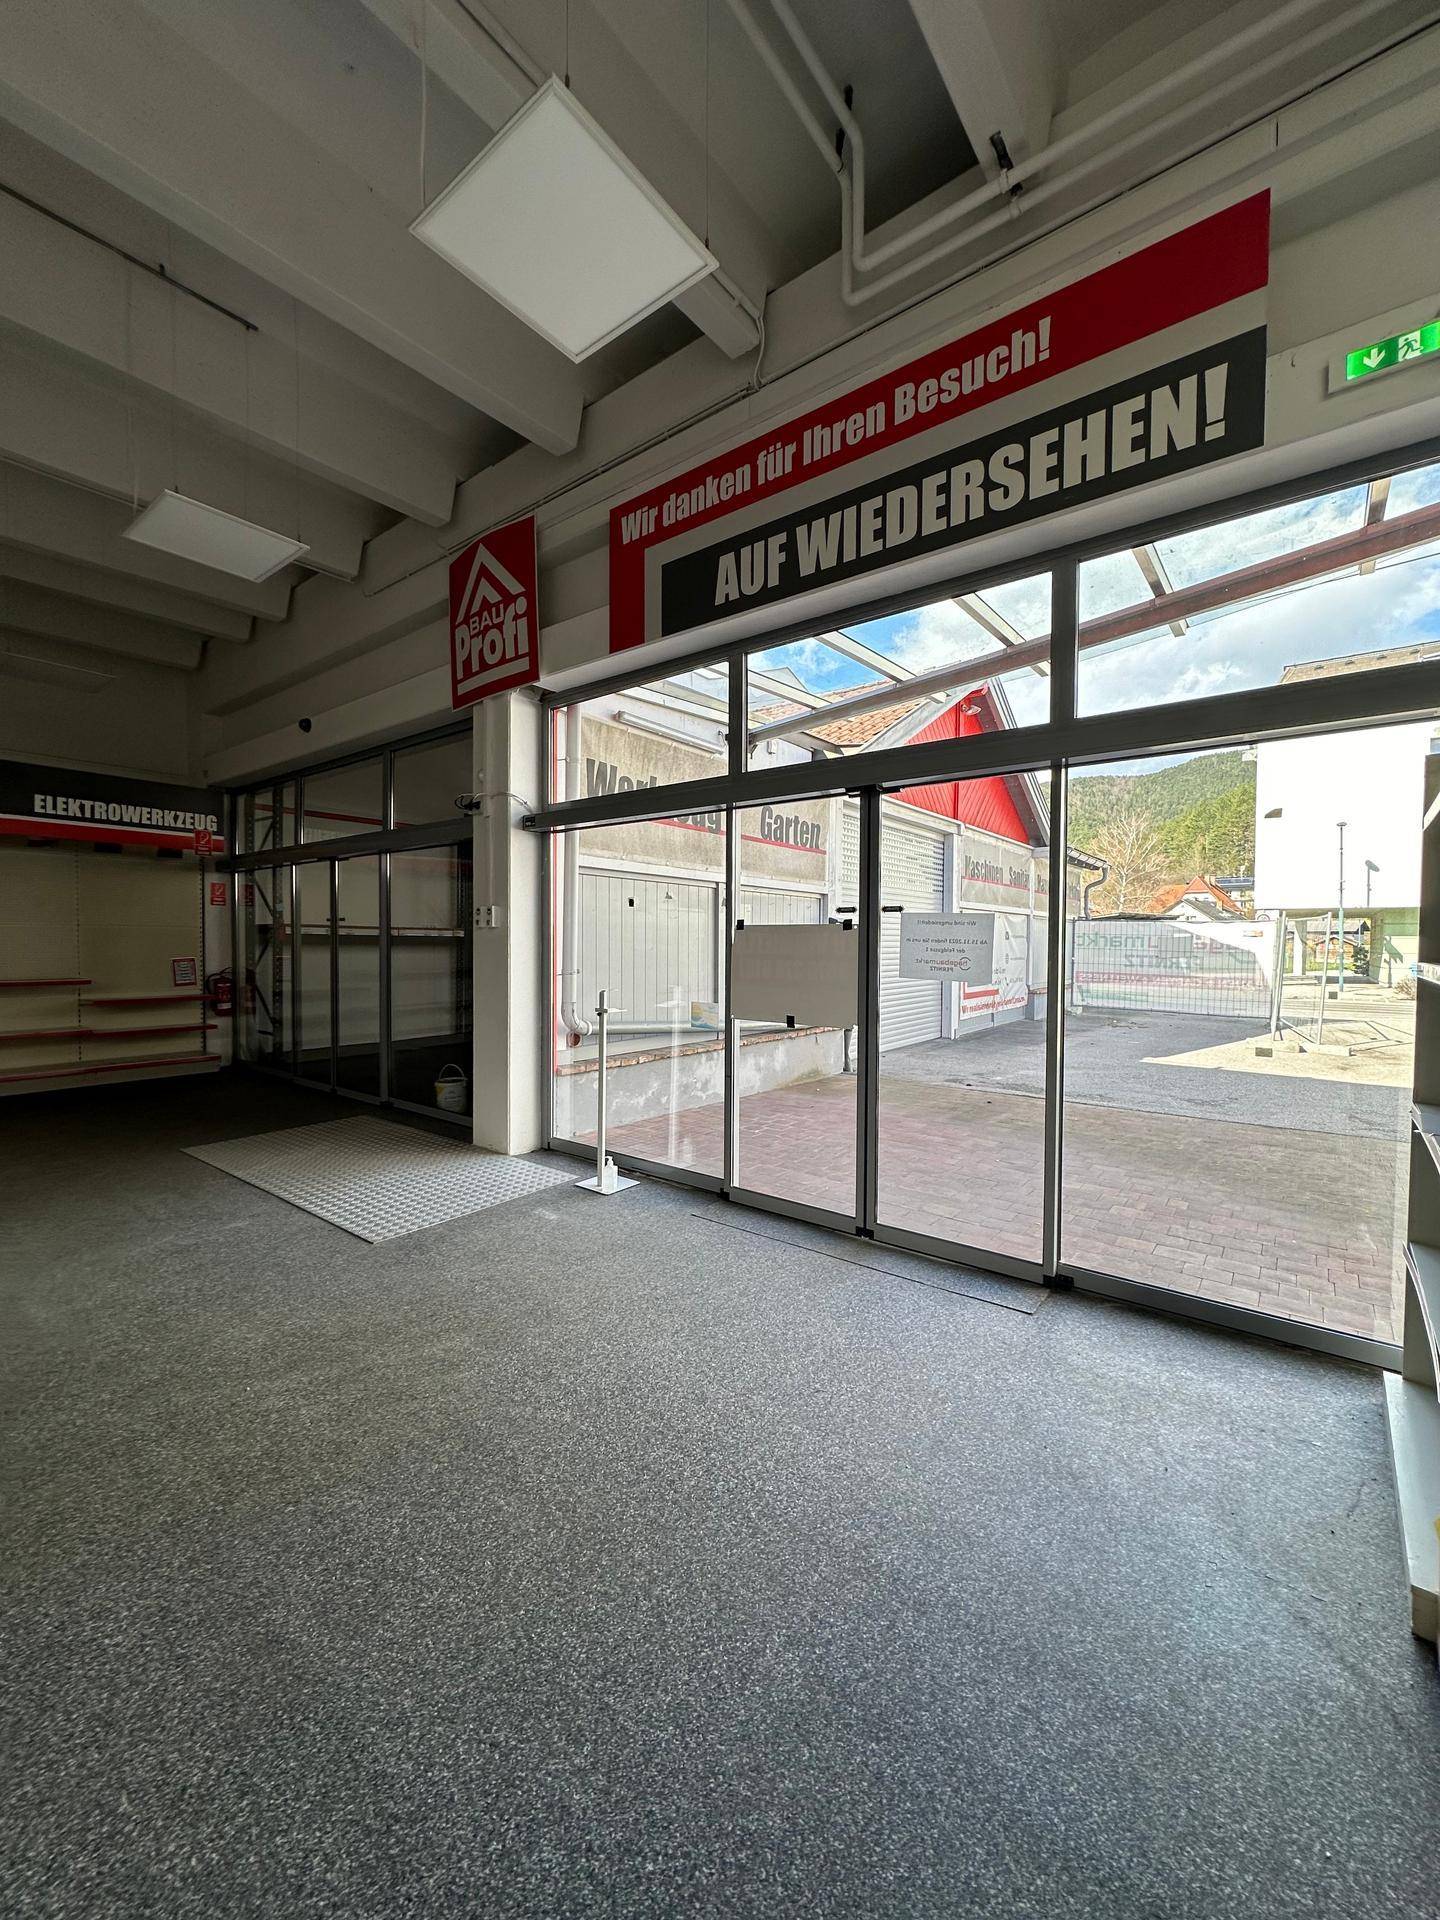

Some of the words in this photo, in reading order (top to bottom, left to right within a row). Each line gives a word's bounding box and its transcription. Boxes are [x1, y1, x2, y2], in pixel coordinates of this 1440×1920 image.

[620, 506, 659, 545] Wir
[662, 462, 752, 529] danken
[757, 440, 798, 487] für
[802, 400, 886, 465] Ihren
[894, 315, 1052, 421] Besuch!
[713, 530, 789, 607] AUF
[795, 362, 1229, 577] WIEDERSEHEN!
[454, 596, 530, 681] Profi
[469, 603, 505, 635] BAU
[33, 793, 218, 832] ELEKTROWERKZEUG
[759, 805, 821, 849] Garten
